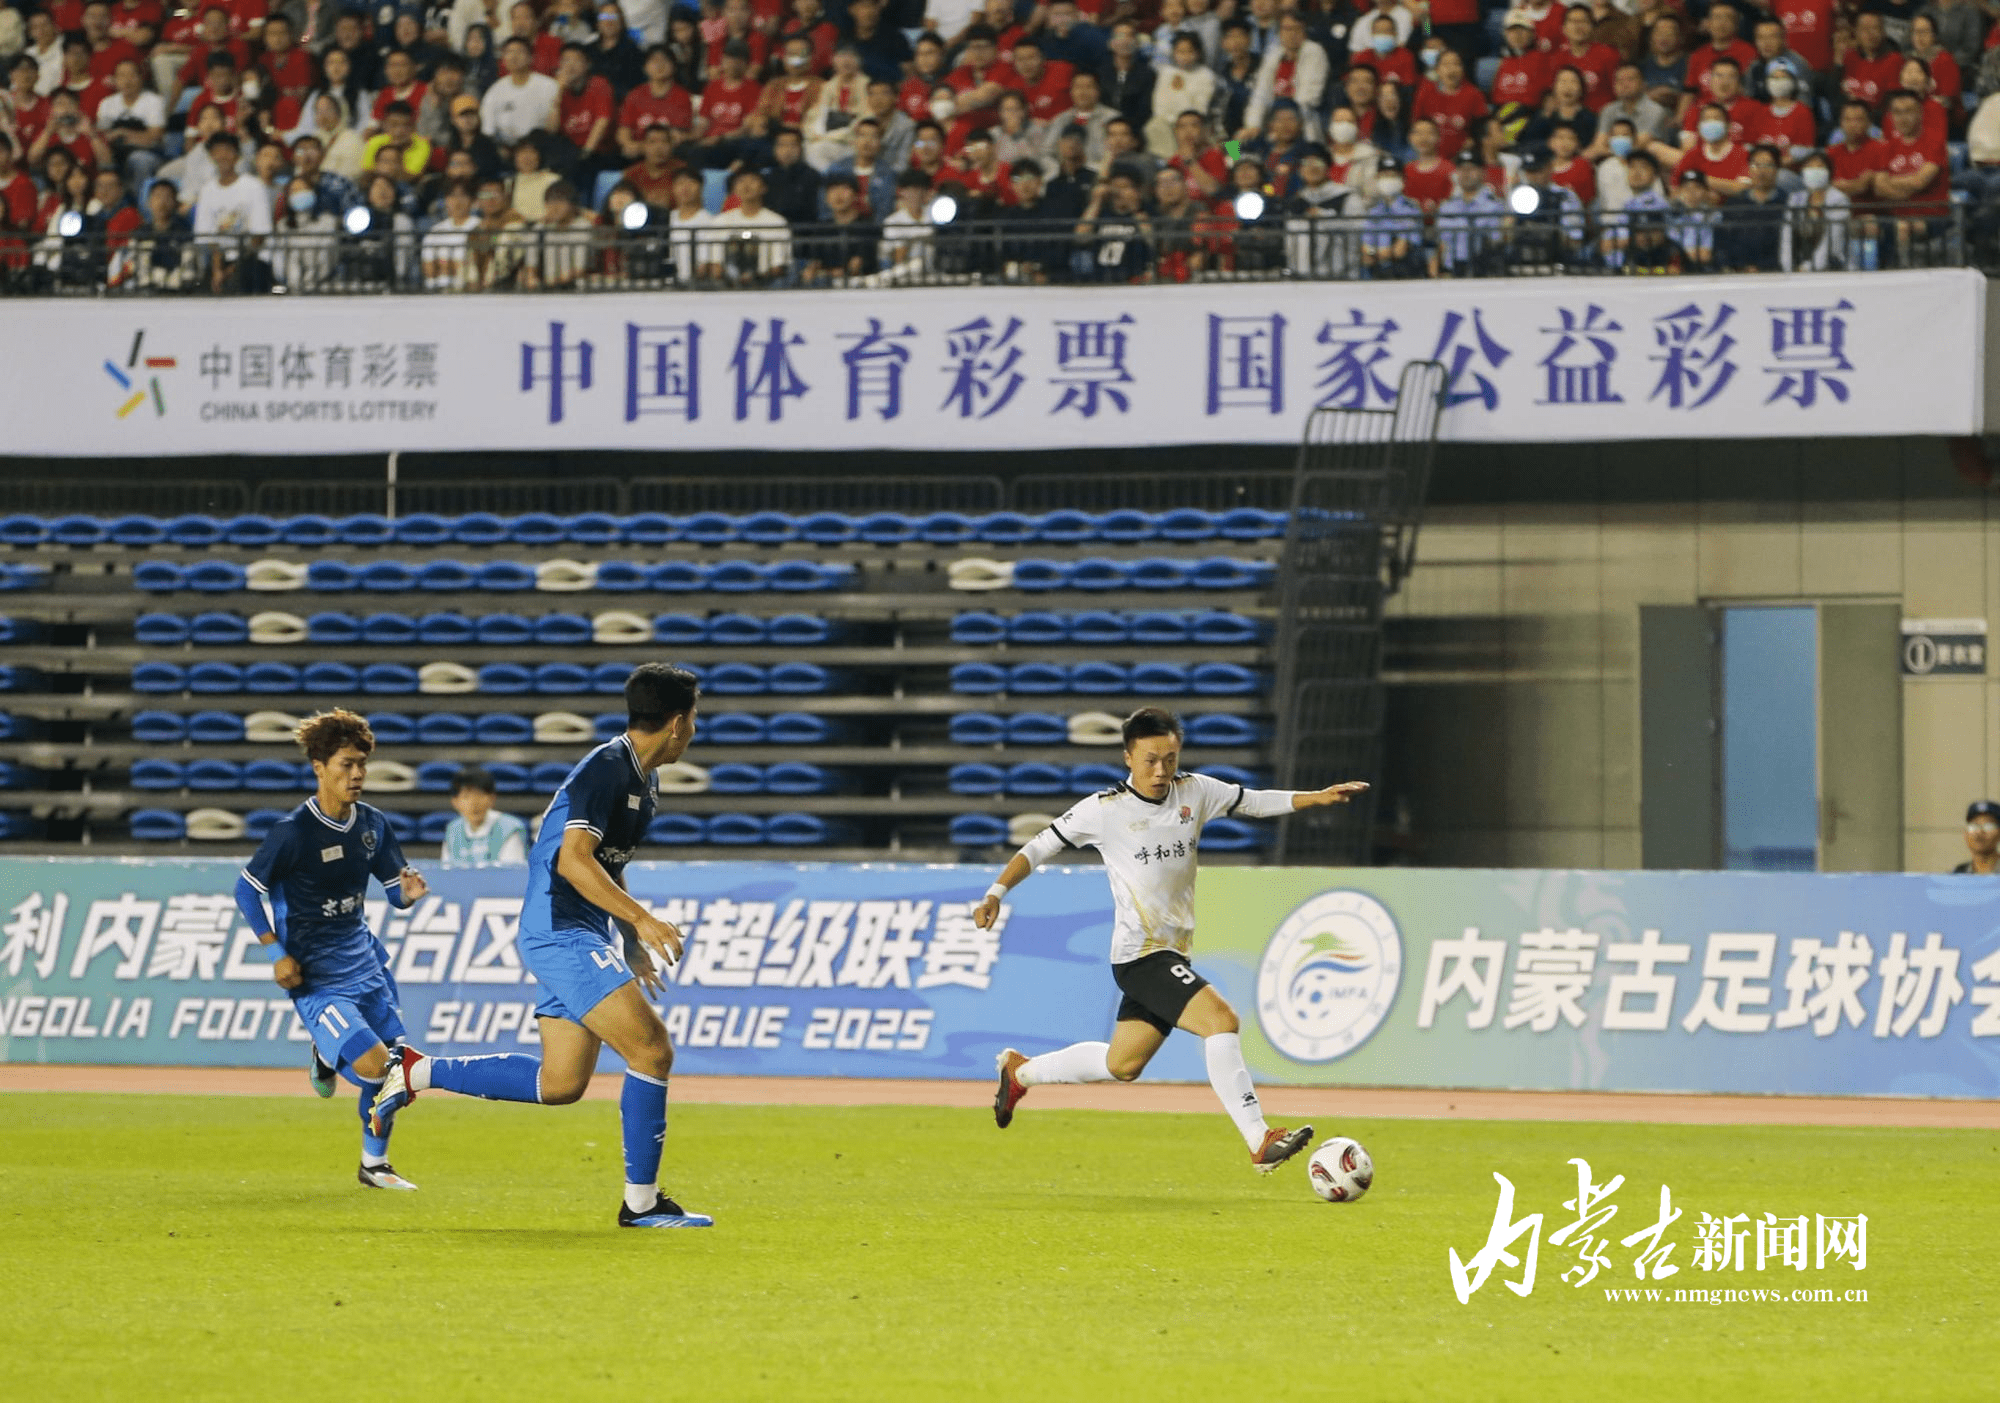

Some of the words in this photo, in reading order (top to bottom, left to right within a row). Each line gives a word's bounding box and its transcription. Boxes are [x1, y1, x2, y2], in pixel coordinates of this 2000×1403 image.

[200, 343, 439, 390] 中国体育彩票
[519, 313, 1137, 424] 中国体育彩票
[1206, 299, 1856, 415] 国家公益彩票
[200, 401, 259, 422] CHINA
[265, 400, 343, 422] SPORTS
[348, 399, 438, 421] LOTTERY
[1170, 964, 1196, 985] 9
[168, 997, 312, 1041] FOOT
[426, 1001, 541, 1044] SUPE
[655, 1005, 790, 1048] AGUE
[803, 1008, 935, 1050] 2025
[318, 1004, 350, 1039] 11
